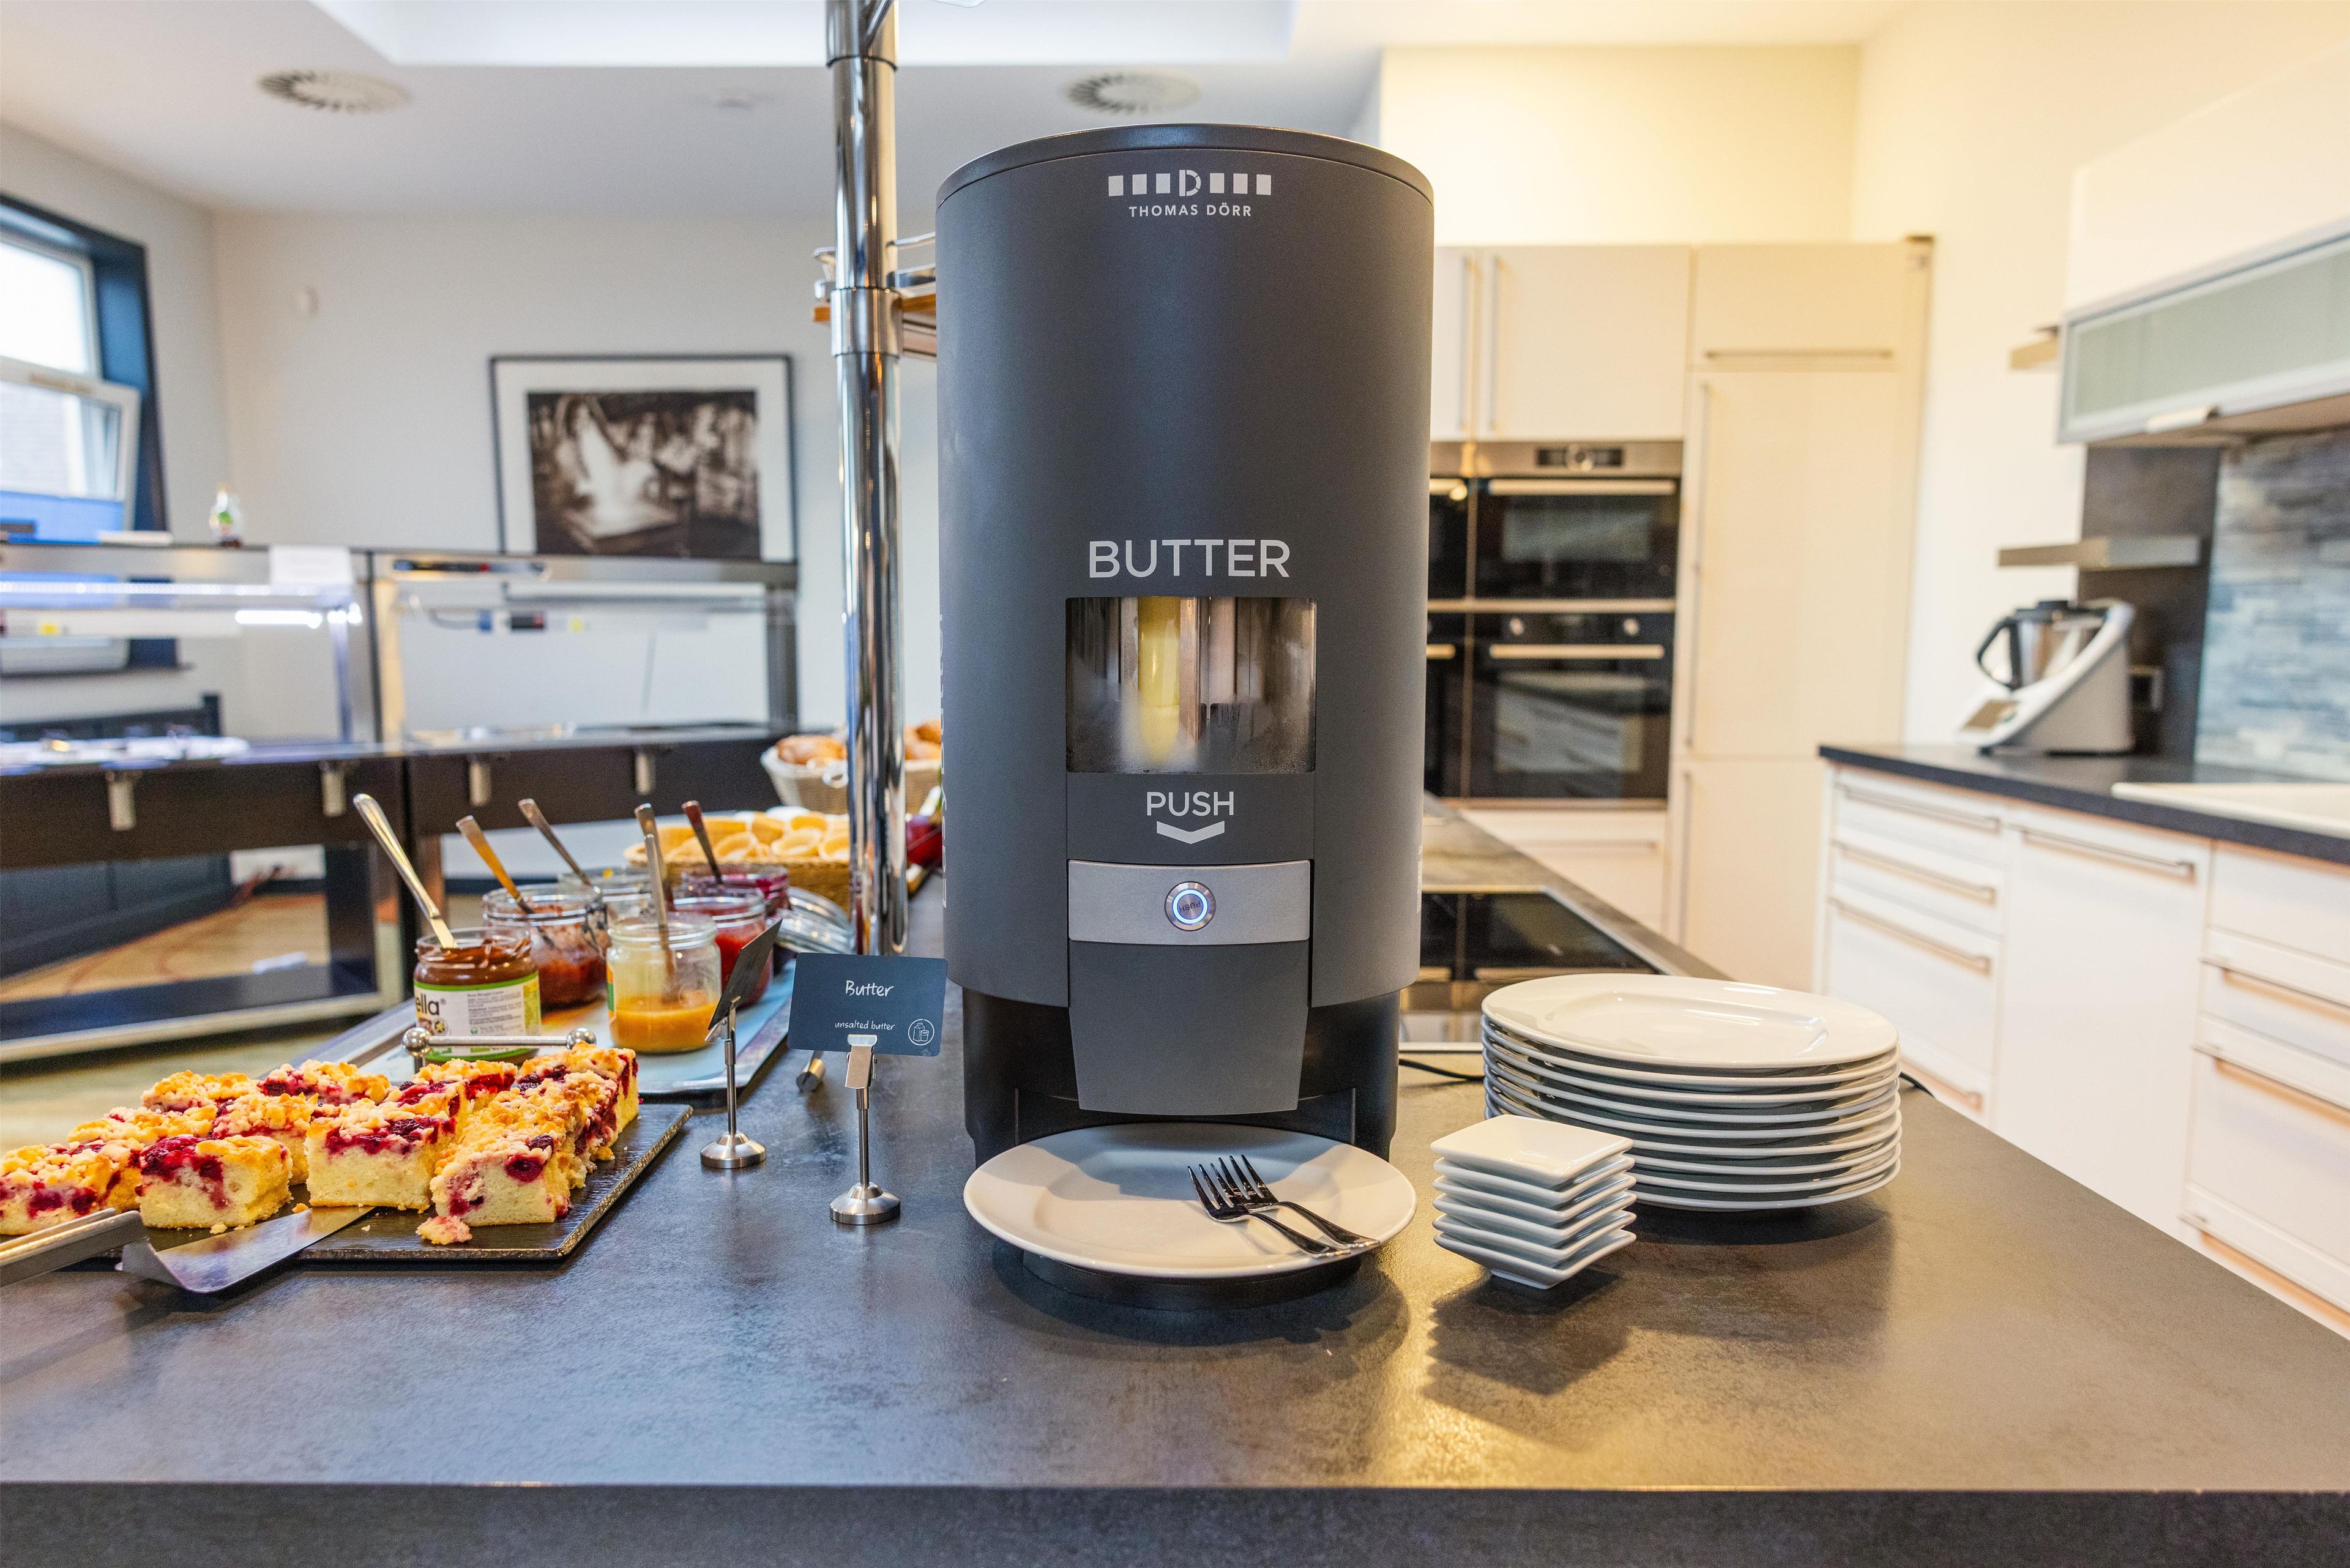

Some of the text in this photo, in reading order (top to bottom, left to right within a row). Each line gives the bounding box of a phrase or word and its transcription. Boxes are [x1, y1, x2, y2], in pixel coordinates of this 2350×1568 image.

[1128, 202, 1251, 217] THOMAS DÖRR
[1089, 539, 1290, 578] BUTTER
[1146, 791, 1234, 816] PUSH
[1179, 901, 1201, 913] PUSH
[845, 980, 894, 997] Butter
[835, 1020, 895, 1031] unsalted butter
